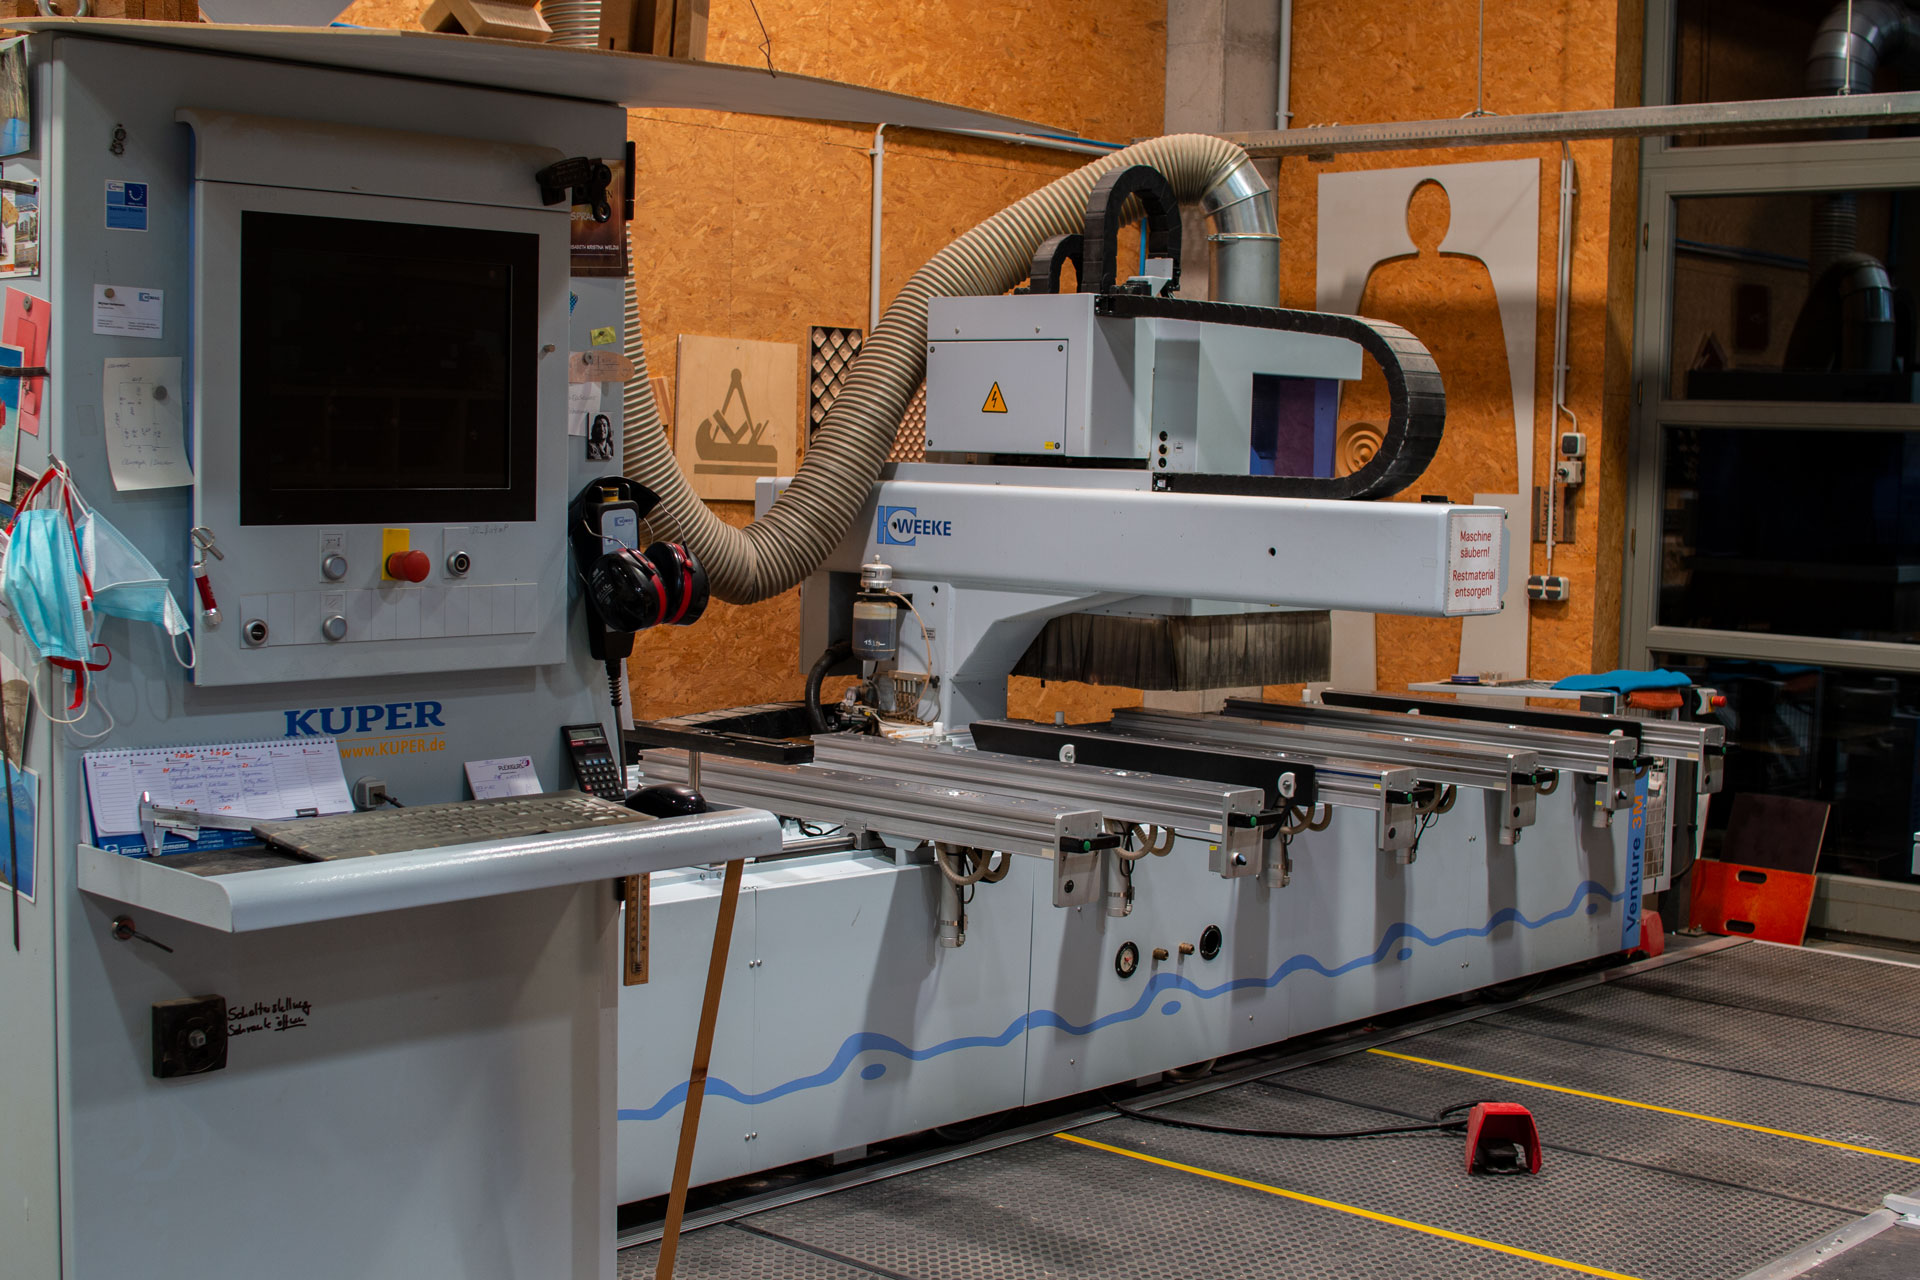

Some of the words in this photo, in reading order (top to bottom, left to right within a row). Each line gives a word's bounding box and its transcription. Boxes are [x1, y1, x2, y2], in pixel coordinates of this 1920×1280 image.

[896, 518, 952, 537] WEEKE
[1460, 530, 1492, 542] Maschine
[1460, 546, 1490, 559] säubern!
[1452, 569, 1496, 581] Restmaterial
[1454, 585, 1492, 600] entsorgen!
[284, 701, 446, 737] KUPER
[341, 738, 446, 759] www.KUPER.de
[1632, 795, 1643, 829] 3M
[1626, 838, 1641, 932] Venture
[227, 1017, 272, 1037] Schrank
